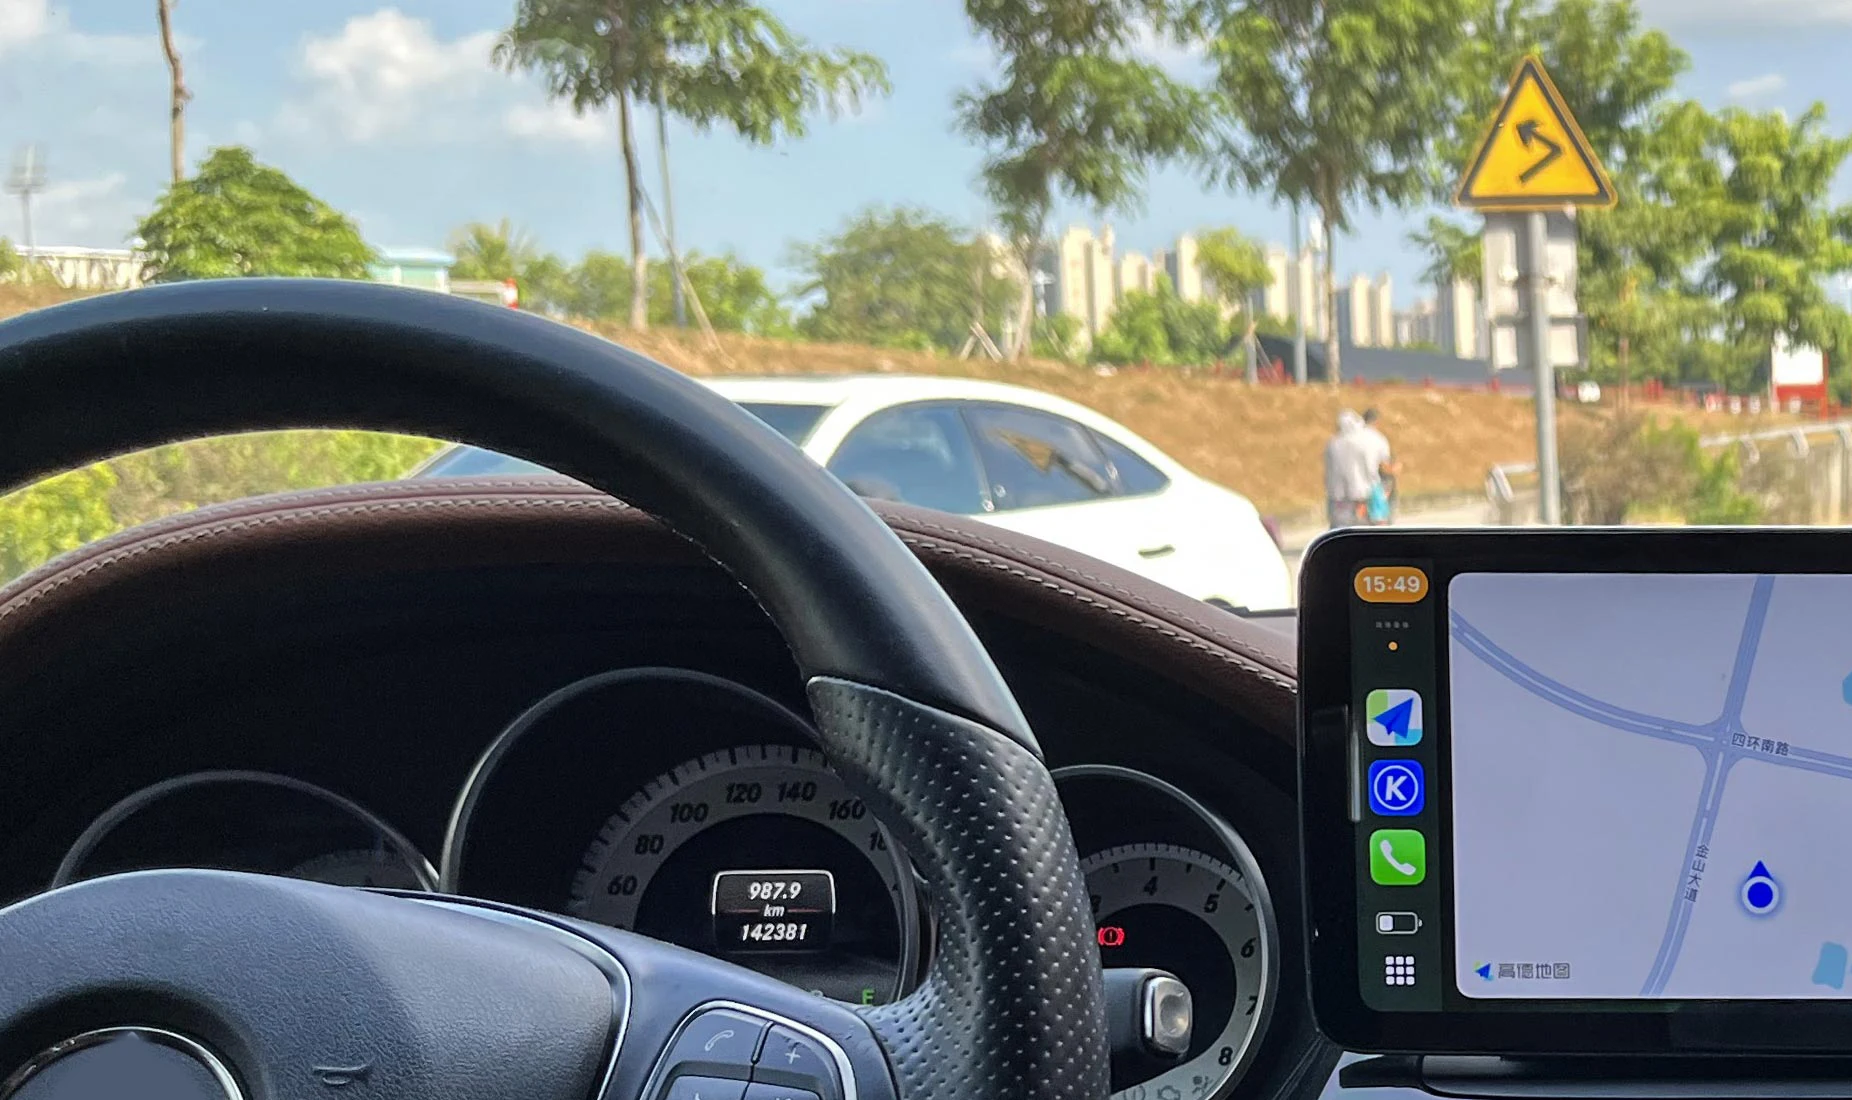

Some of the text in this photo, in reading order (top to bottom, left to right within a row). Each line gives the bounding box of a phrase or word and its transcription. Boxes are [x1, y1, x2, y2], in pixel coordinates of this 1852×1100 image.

[1363, 576, 1420, 593] 15:49
[1731, 732, 1790, 756] 四环南路
[724, 782, 762, 803] 120
[776, 781, 817, 802] 140
[1385, 775, 1408, 801] K
[669, 803, 709, 823] 100
[829, 800, 866, 821] 160
[634, 834, 664, 855] 80
[1684, 844, 1710, 903] 金山大道
[607, 875, 638, 896] 60
[748, 881, 802, 901] 987.9
[1144, 876, 1158, 896] 4
[763, 904, 785, 917] km
[1204, 893, 1219, 914] 5
[741, 922, 808, 942] 142381
[1240, 937, 1257, 958] 6
[1218, 1046, 1233, 1066] 8
